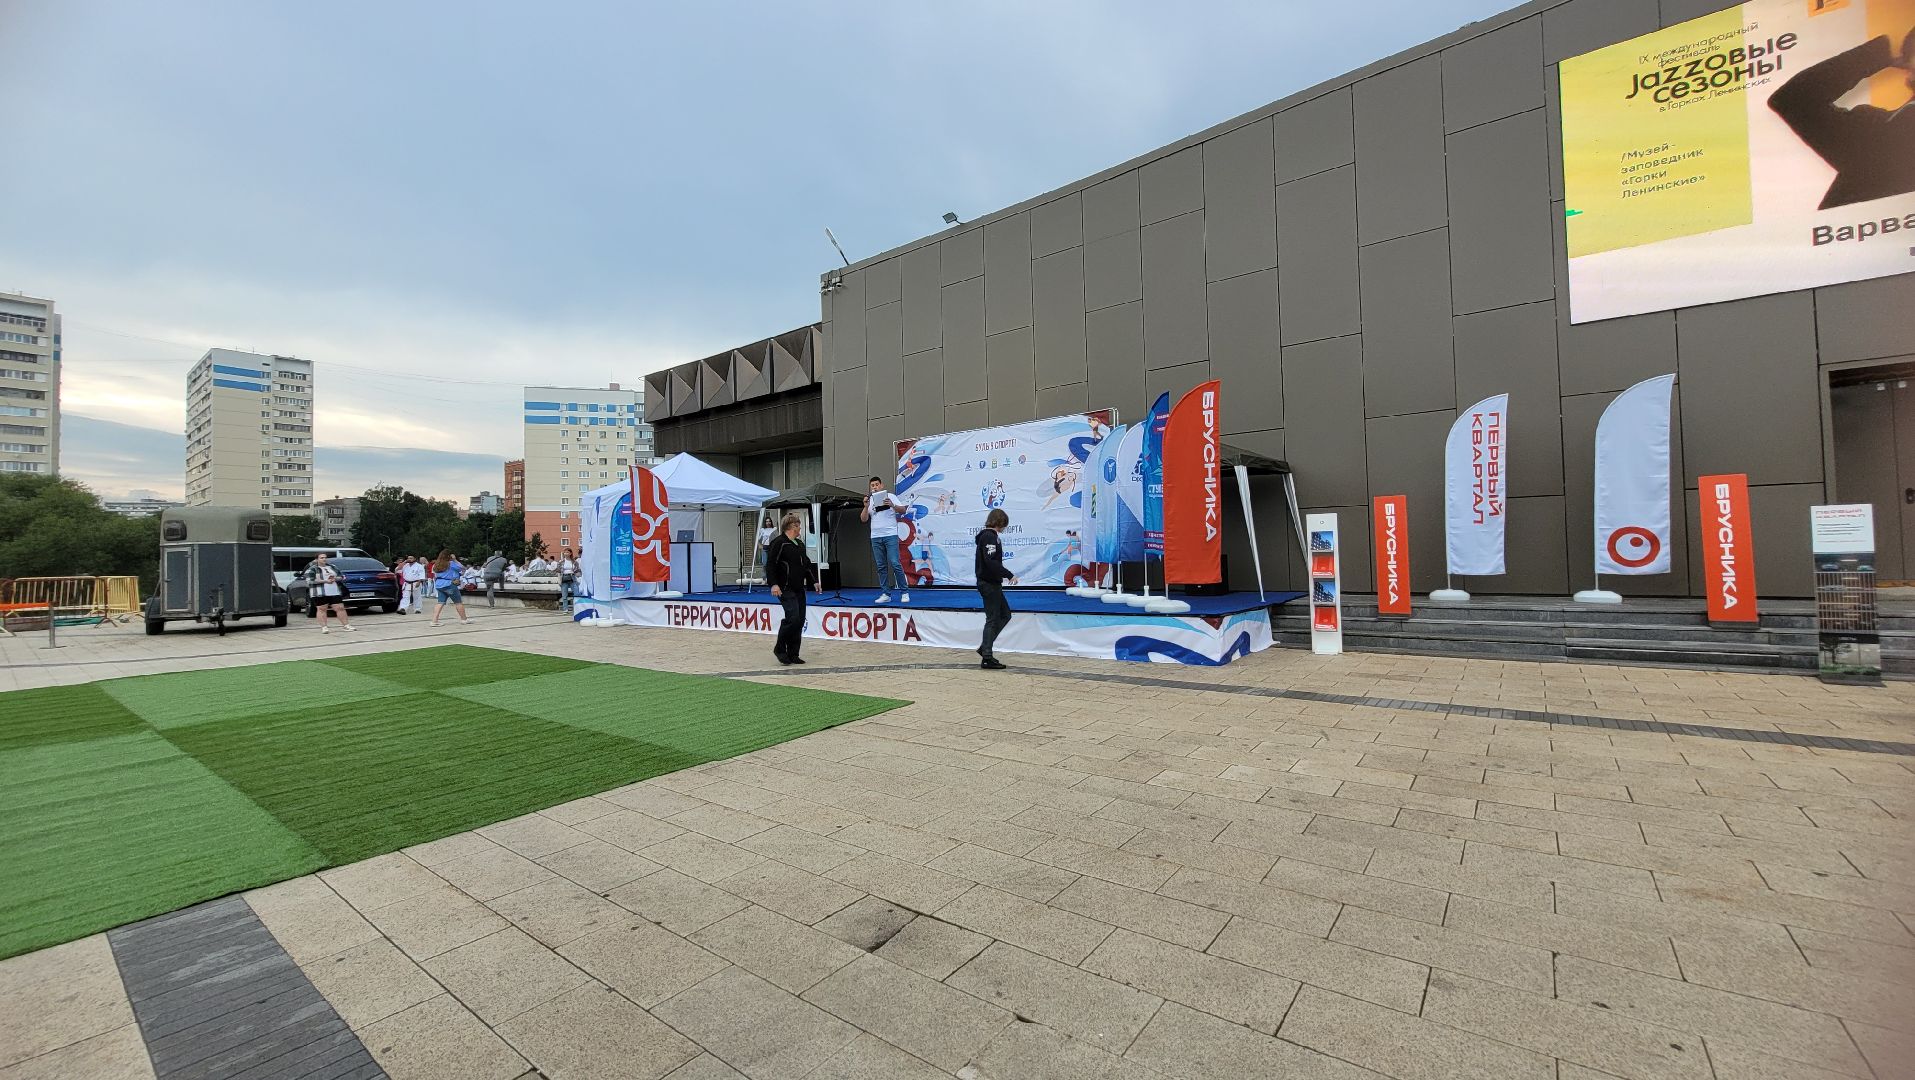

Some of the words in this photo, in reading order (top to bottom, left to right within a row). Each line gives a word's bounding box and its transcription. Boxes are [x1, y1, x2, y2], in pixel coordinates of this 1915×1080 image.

[1653, 22, 1759, 59] международный
[1657, 45, 1721, 68] фестиваль
[1625, 32, 1798, 100] Jazzовые
[1653, 54, 1783, 104] сезоны
[1667, 95, 1705, 112] Горках
[1708, 77, 1772, 100] Ленинских
[1621, 149, 1704, 174] заповедник
[1621, 171, 1667, 186] «Горки
[1622, 175, 1705, 199] Ленинские»
[1202, 391, 1217, 542] БРУСНИКА
[1472, 413, 1484, 525] КВАРТАЛ
[1488, 412, 1503, 517] ПЕРВЫЙ
[1384, 503, 1399, 605] БРУСНИКА
[1715, 483, 1738, 610] БРУСНИКА
[664, 605, 772, 631] ТЕРРИТОРИЯ
[822, 611, 922, 642] СПОРТА
